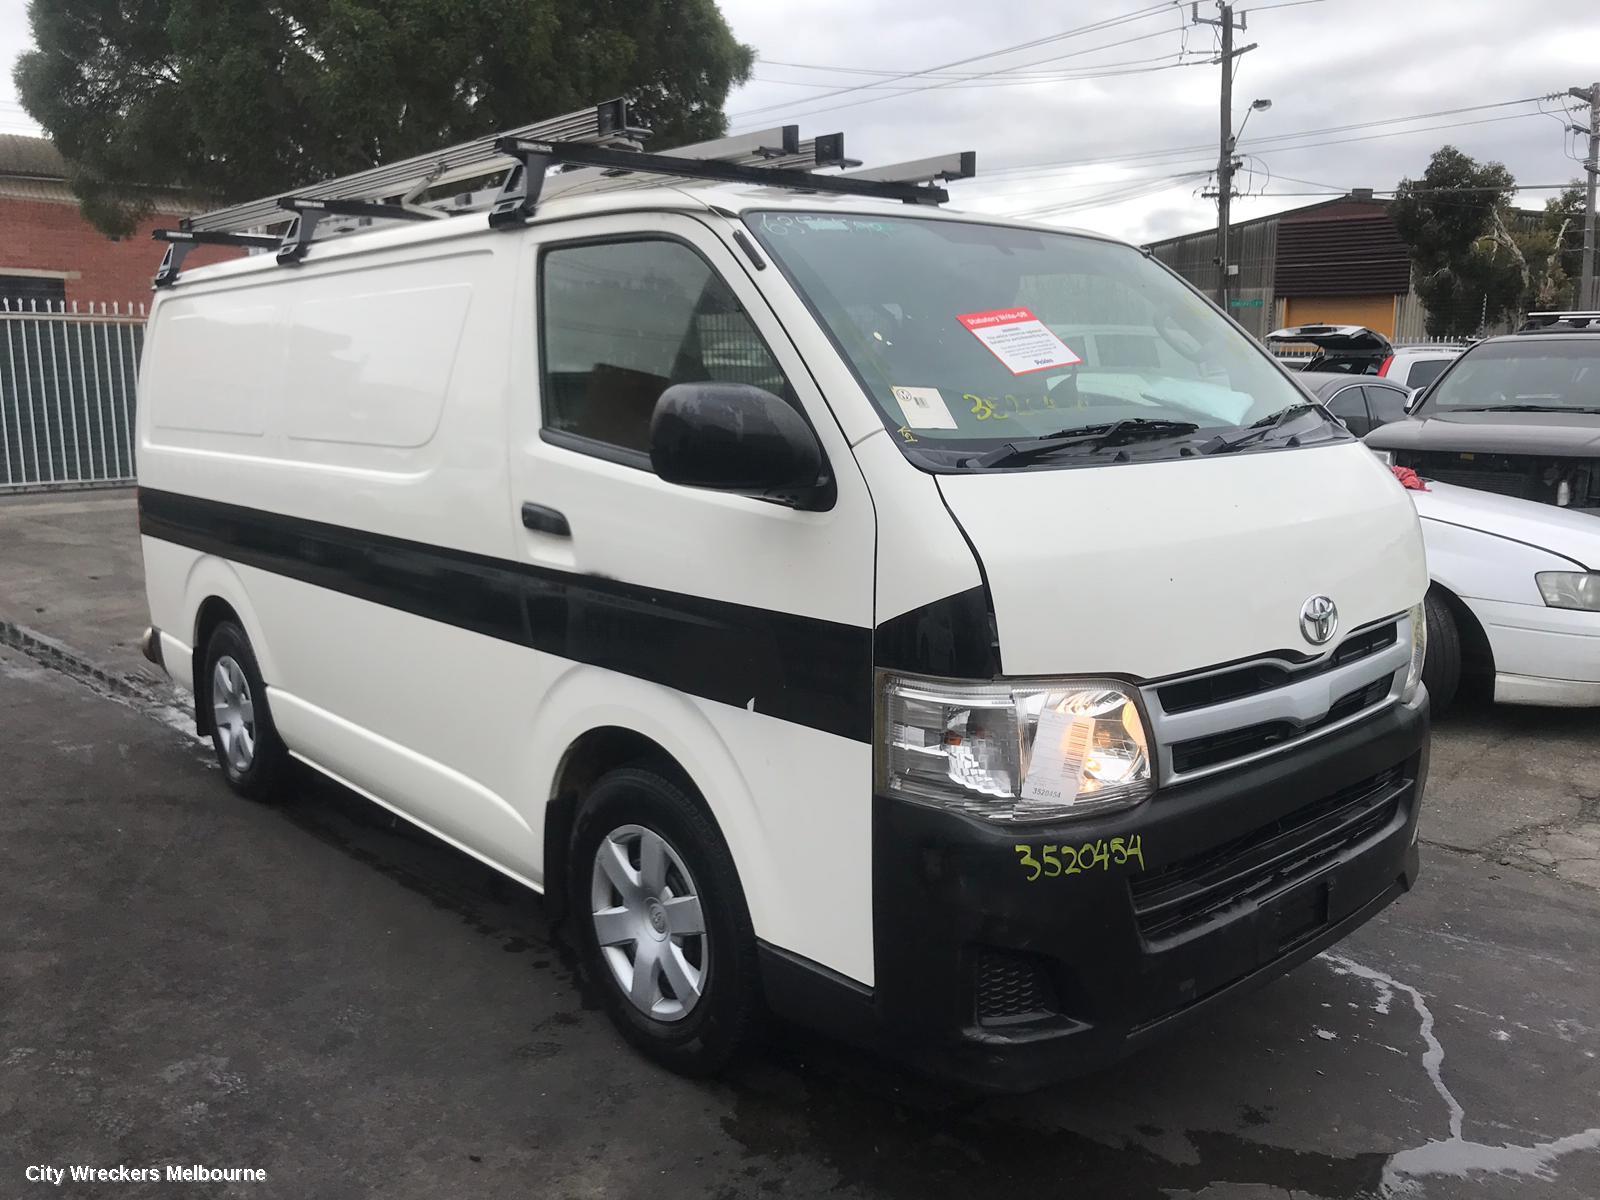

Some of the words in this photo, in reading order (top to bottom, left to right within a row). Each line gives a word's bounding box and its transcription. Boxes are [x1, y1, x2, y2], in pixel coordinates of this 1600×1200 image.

[967, 314, 999, 326] Statutory
[1032, 787, 1062, 799] 3520454
[1015, 833, 1145, 882] 3520454
